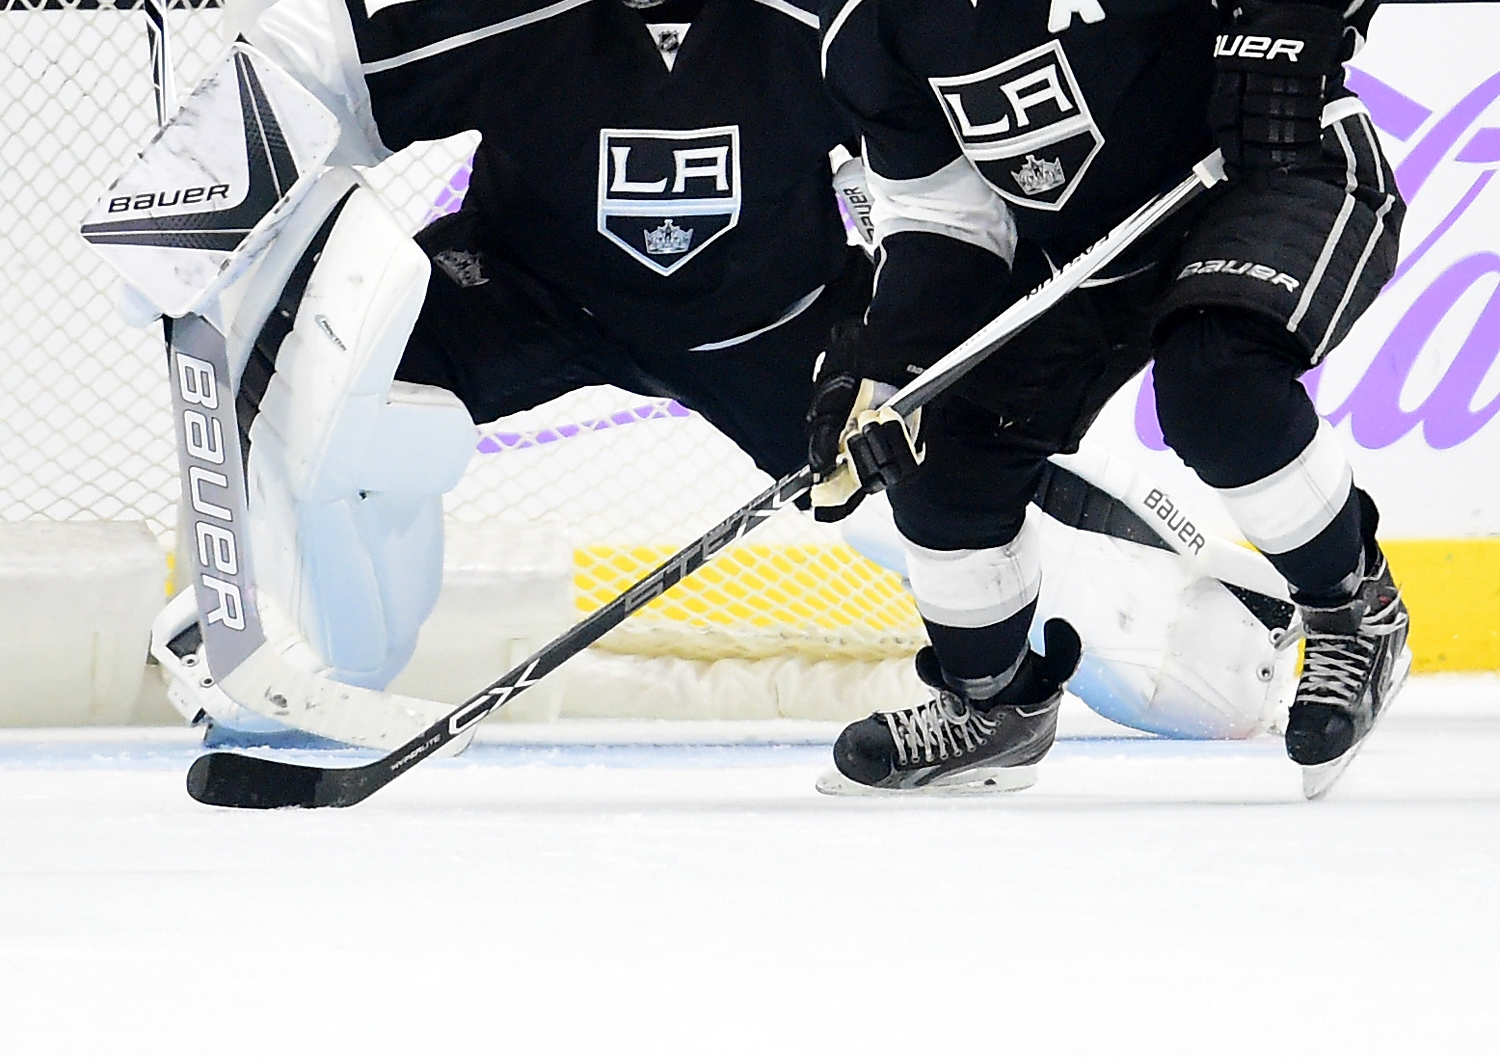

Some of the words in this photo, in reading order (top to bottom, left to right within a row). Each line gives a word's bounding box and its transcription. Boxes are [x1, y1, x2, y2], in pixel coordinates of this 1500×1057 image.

[1213, 34, 1305, 62] UER
[943, 66, 1074, 137] LA
[108, 183, 230, 214] BAUER
[610, 146, 730, 194] LA
[175, 349, 246, 634] BAUER
[1143, 488, 1206, 556] BAUER
[448, 657, 541, 735] CX
